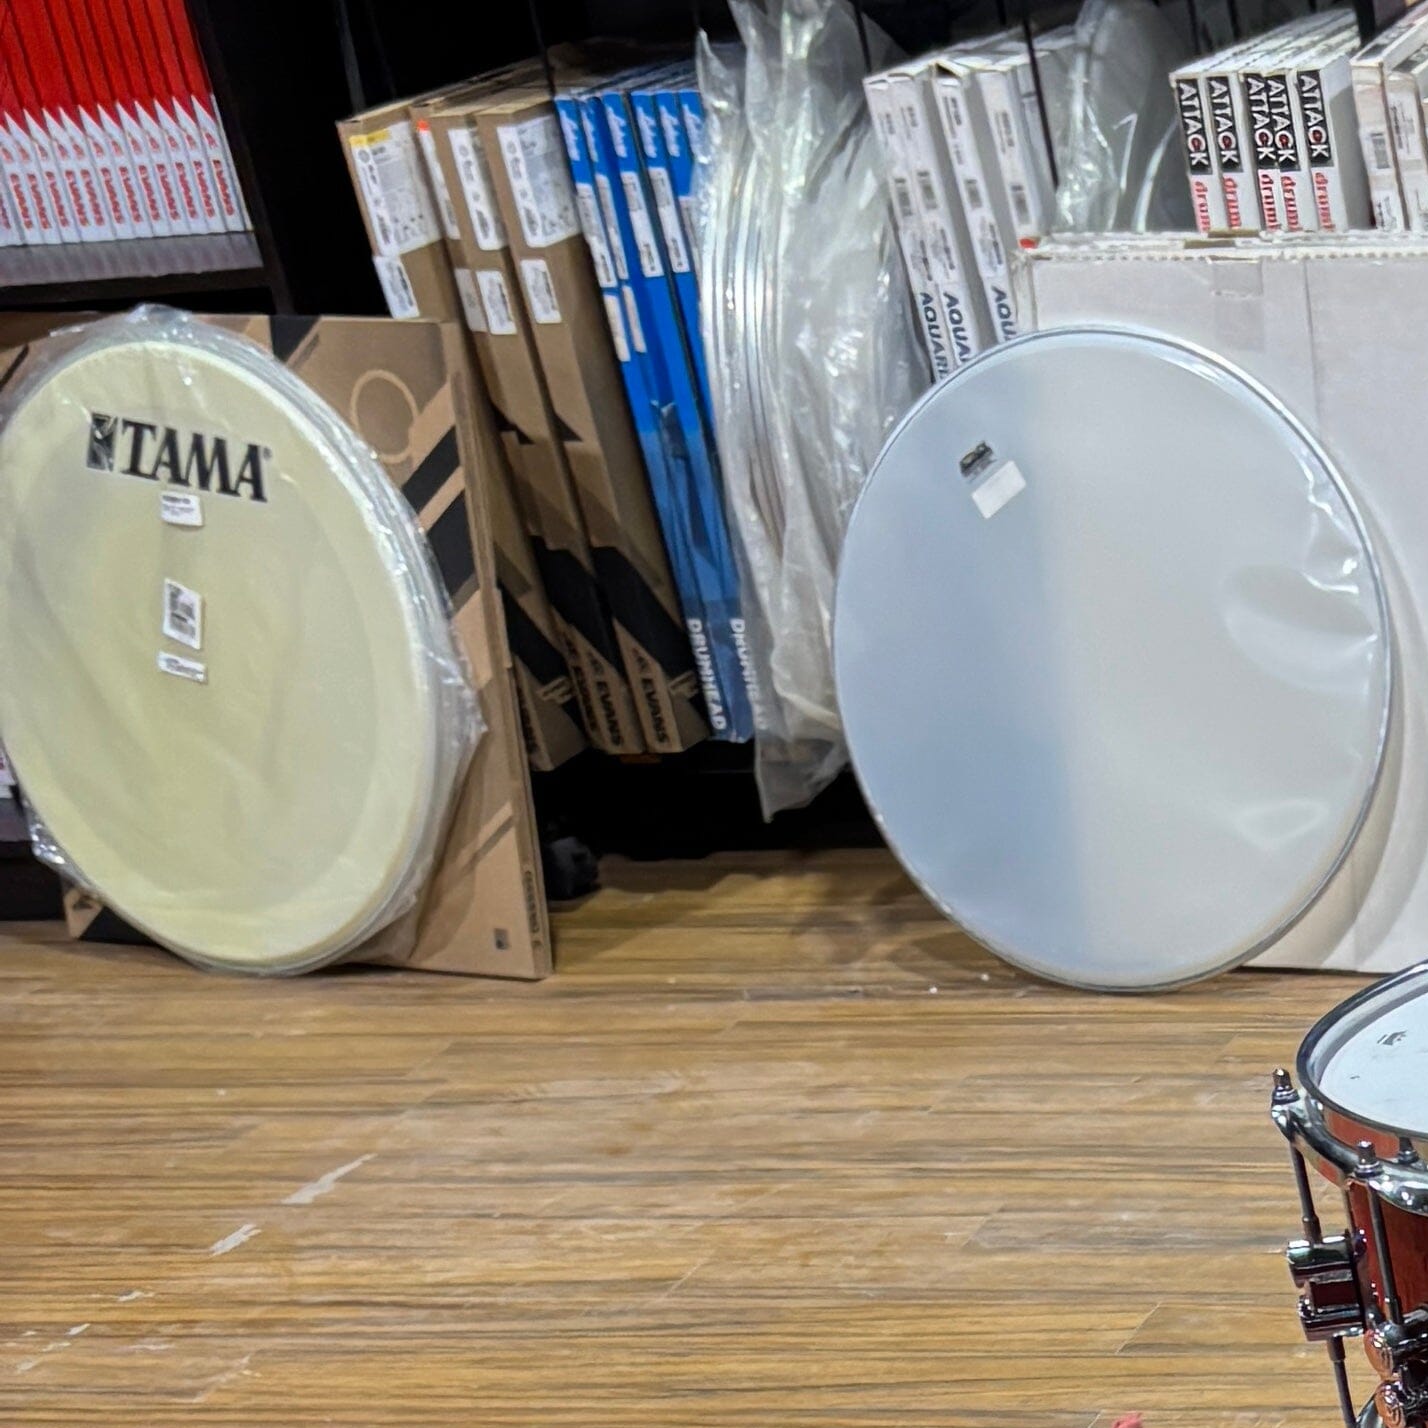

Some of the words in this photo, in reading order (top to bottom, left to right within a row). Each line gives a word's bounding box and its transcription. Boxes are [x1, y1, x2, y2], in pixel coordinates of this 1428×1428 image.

[1179, 82, 1209, 166] ATTACK
[1209, 80, 1239, 164] ATTACK
[1247, 78, 1276, 160] ATTACK
[1267, 80, 1297, 162] ATTACK
[1300, 75, 1329, 158] ATTACK
[920, 291, 949, 380] AQUARI
[992, 285, 1017, 341] AQU
[121, 418, 268, 503] TAMA
[641, 678, 669, 744] EVANS
[687, 618, 728, 730] DRUMHEAD
